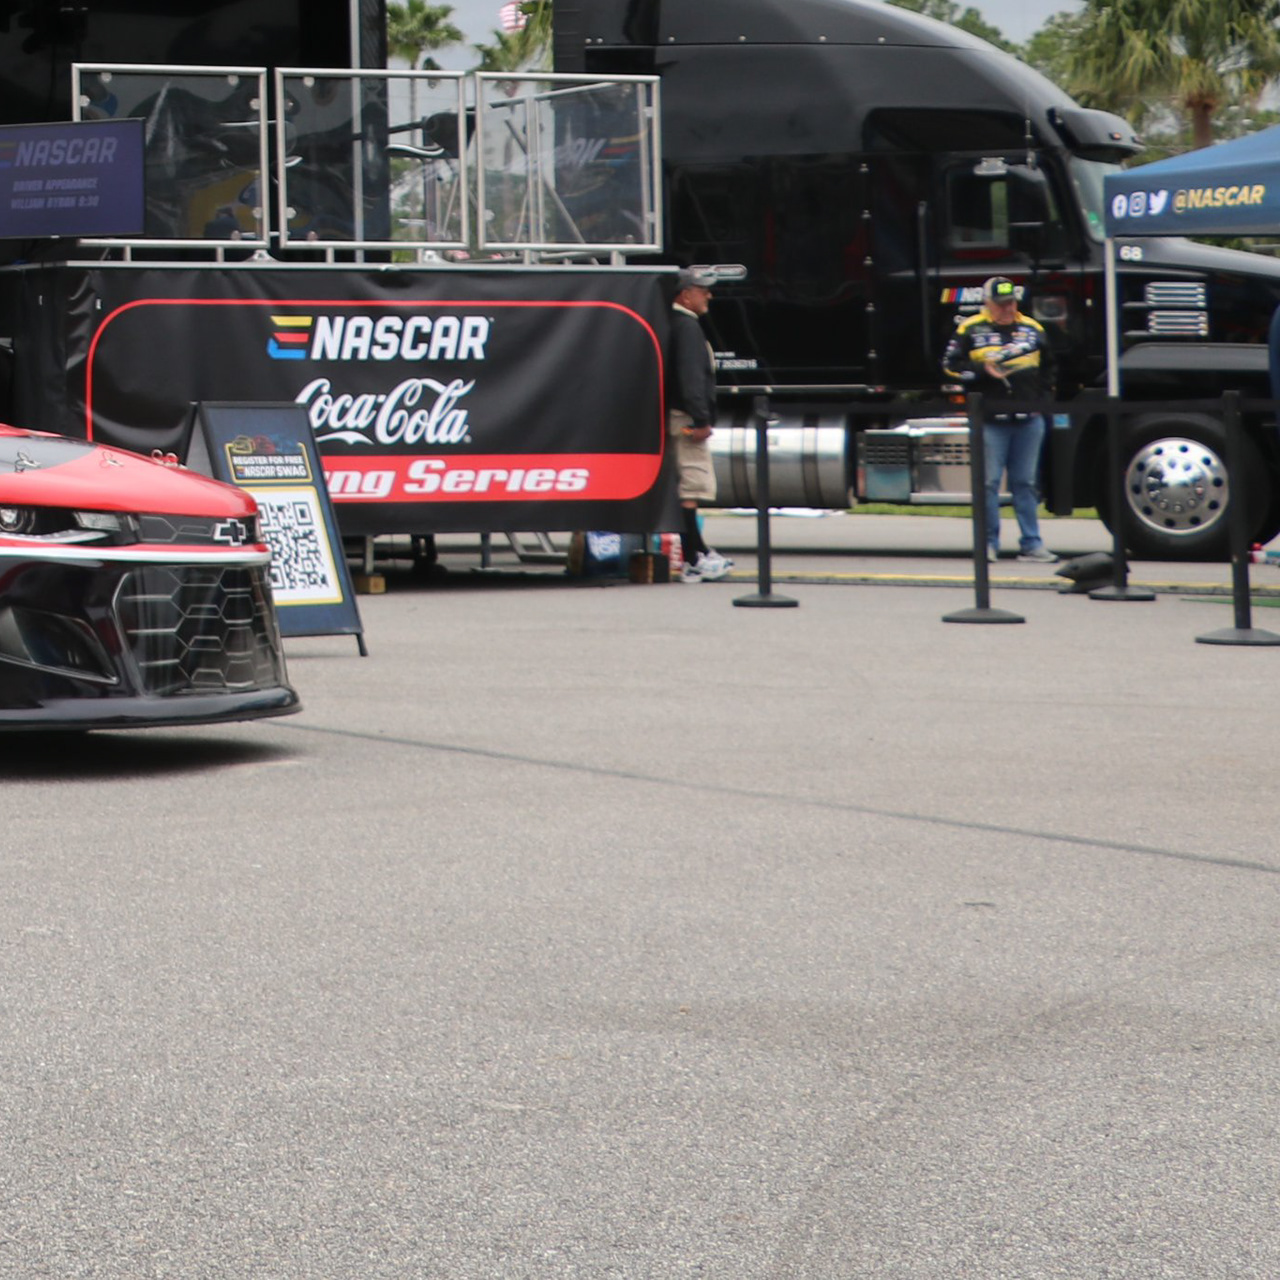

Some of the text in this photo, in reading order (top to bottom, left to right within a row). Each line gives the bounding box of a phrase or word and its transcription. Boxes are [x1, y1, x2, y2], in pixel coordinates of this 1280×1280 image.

[1172, 184, 1266, 214] @NASCAR
[1119, 245, 1143, 262] 68
[268, 456, 284, 465] FOR
[284, 456, 304, 464] FREE
[276, 465, 307, 477] SWAG
[403, 459, 589, 494] Series
